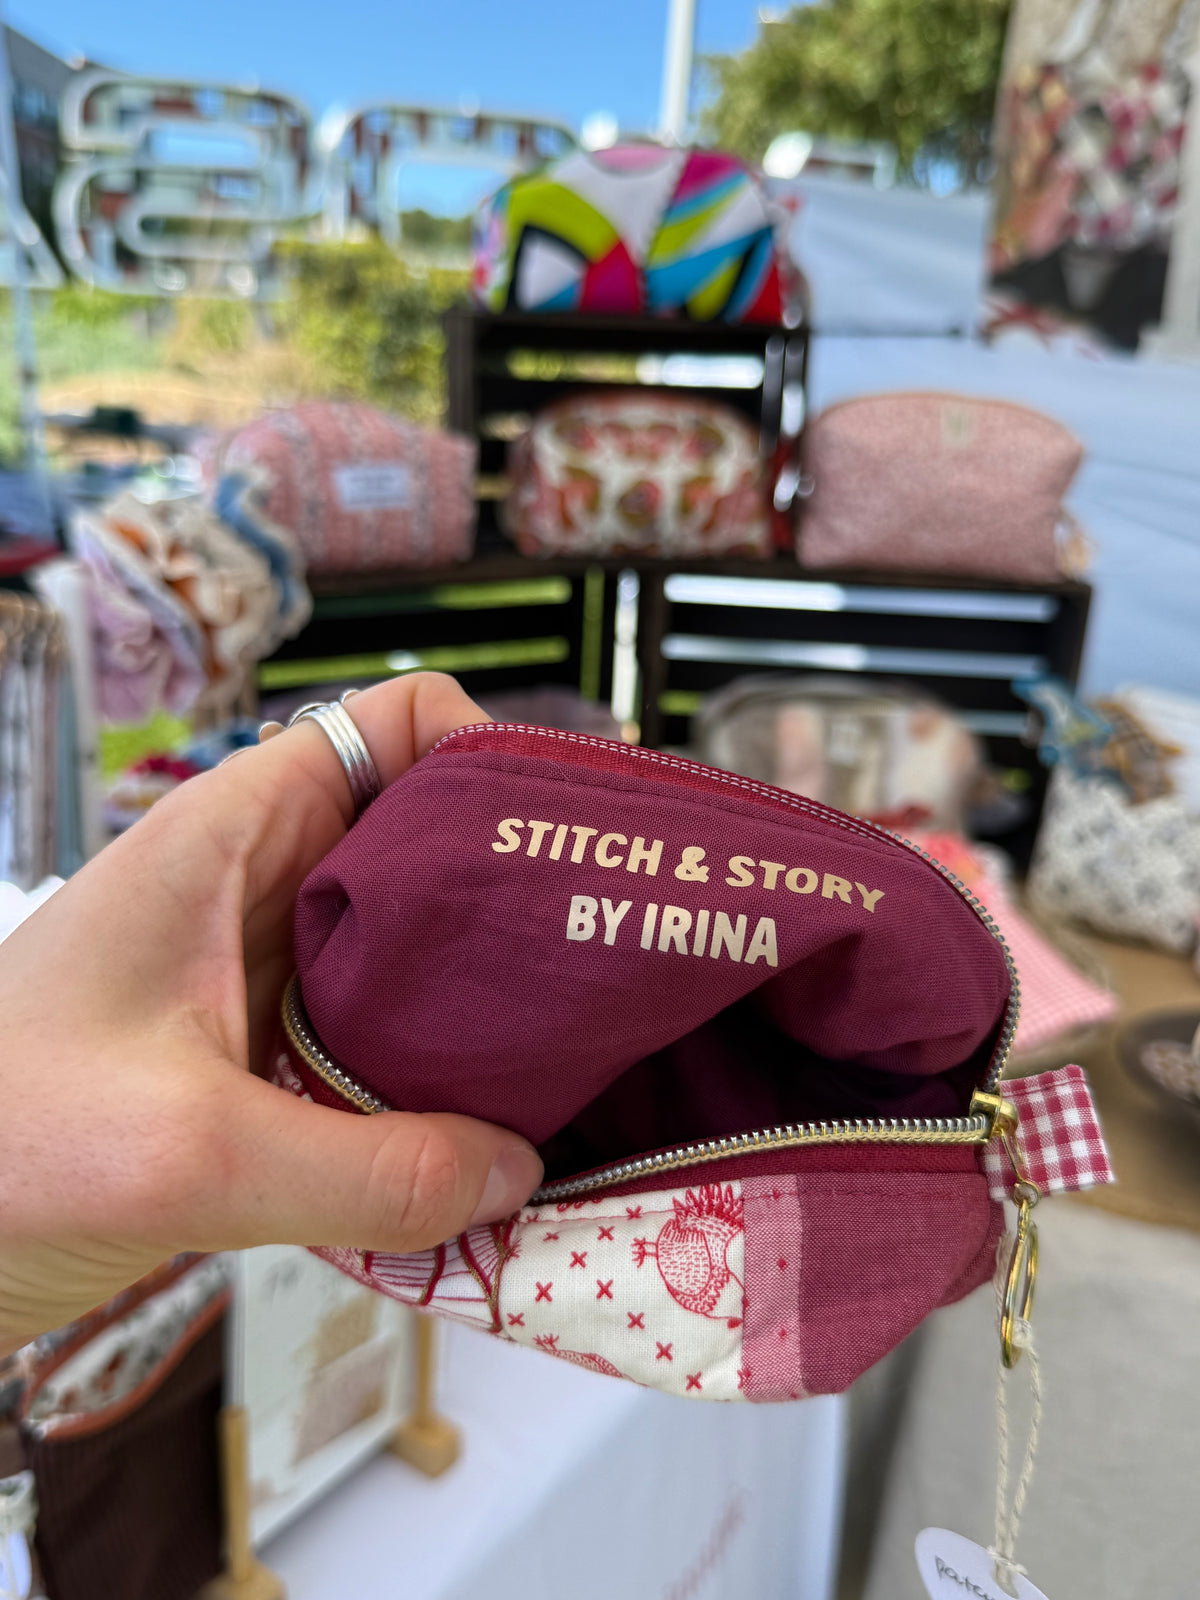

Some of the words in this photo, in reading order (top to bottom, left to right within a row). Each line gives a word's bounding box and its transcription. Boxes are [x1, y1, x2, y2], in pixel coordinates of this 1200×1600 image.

[491, 818, 664, 877] STITCH
[674, 845, 711, 883] &
[724, 855, 886, 914] STORY
[566, 894, 633, 946] BY
[640, 902, 779, 968] IRINA
